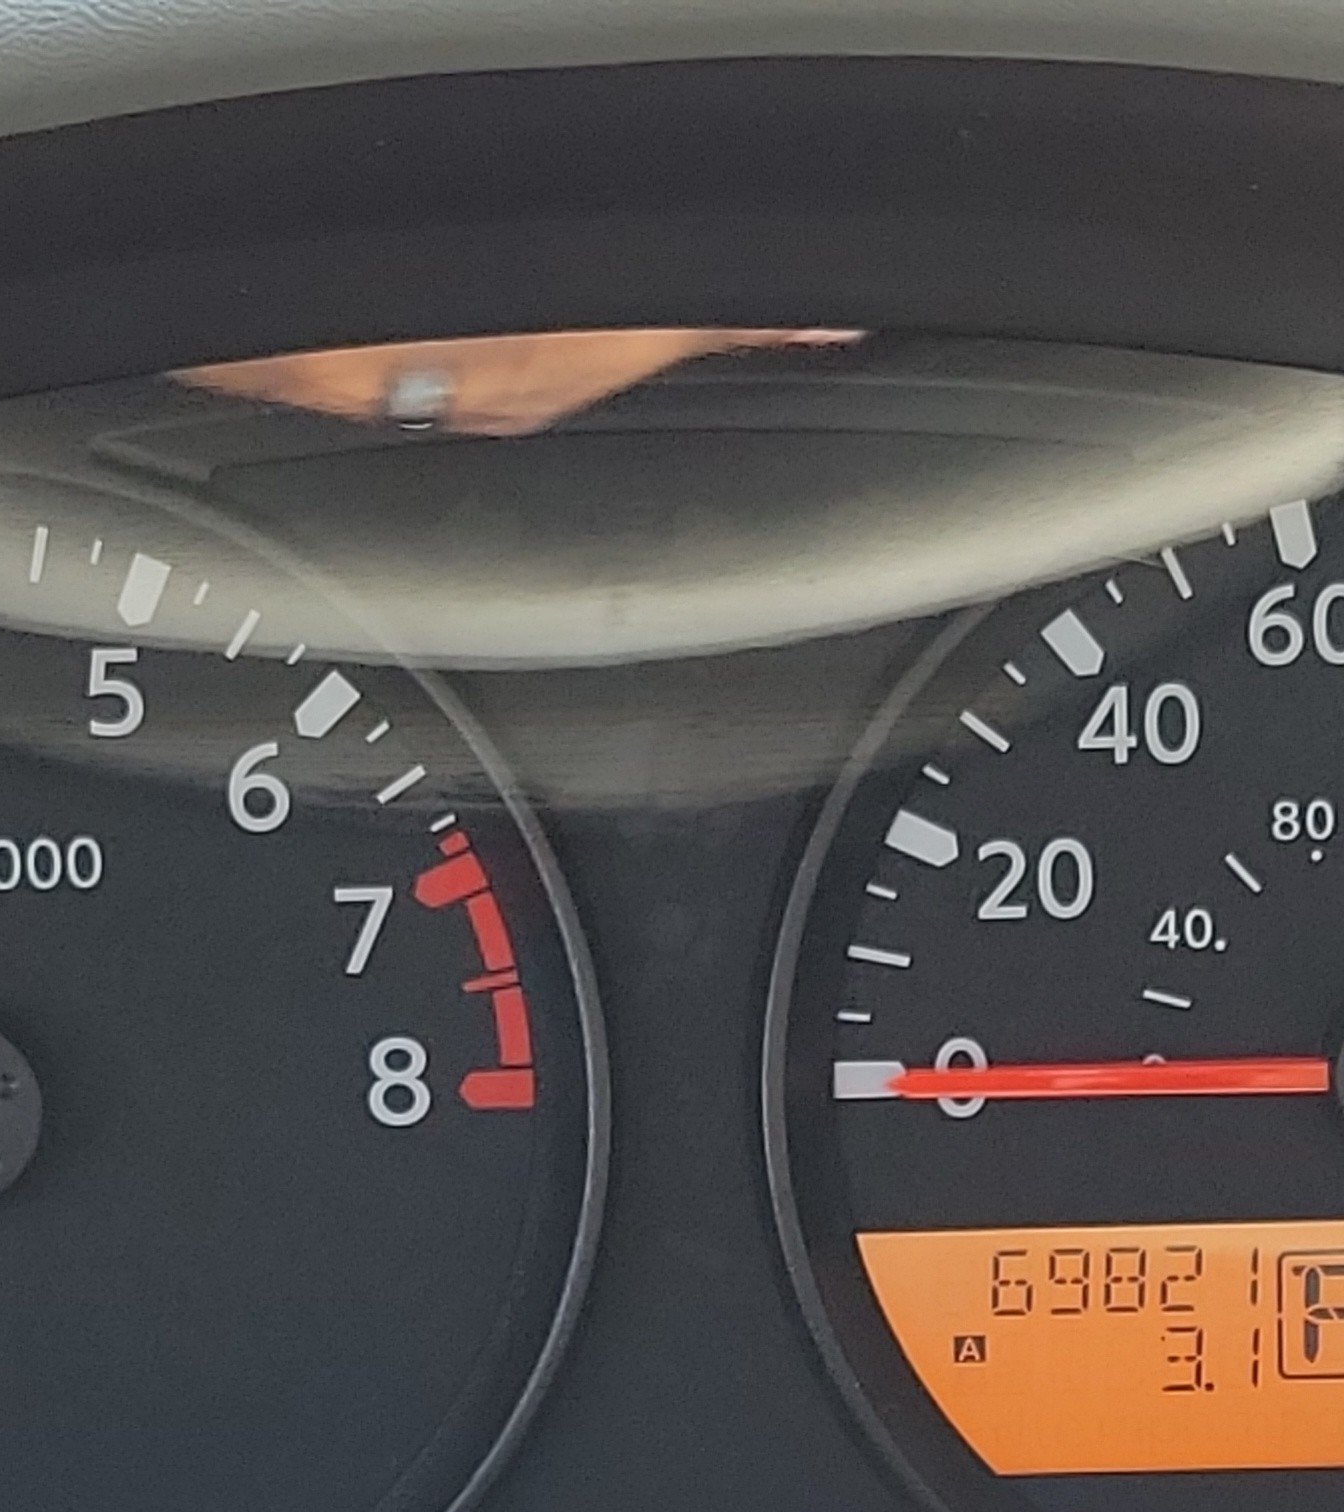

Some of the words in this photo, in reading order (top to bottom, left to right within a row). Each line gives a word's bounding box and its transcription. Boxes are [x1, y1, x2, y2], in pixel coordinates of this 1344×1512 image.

[88, 648, 145, 737] 5
[1078, 683, 1200, 764] 40
[228, 742, 290, 832] 6
[1271, 800, 1334, 841] 80
[978, 838, 1093, 920] 20
[334, 887, 393, 975] 7
[368, 1036, 431, 1127] 8
[991, 1245, 1260, 1316] 69821
[957, 1337, 983, 1362] A
[1161, 1325, 1260, 1392] 3.1
